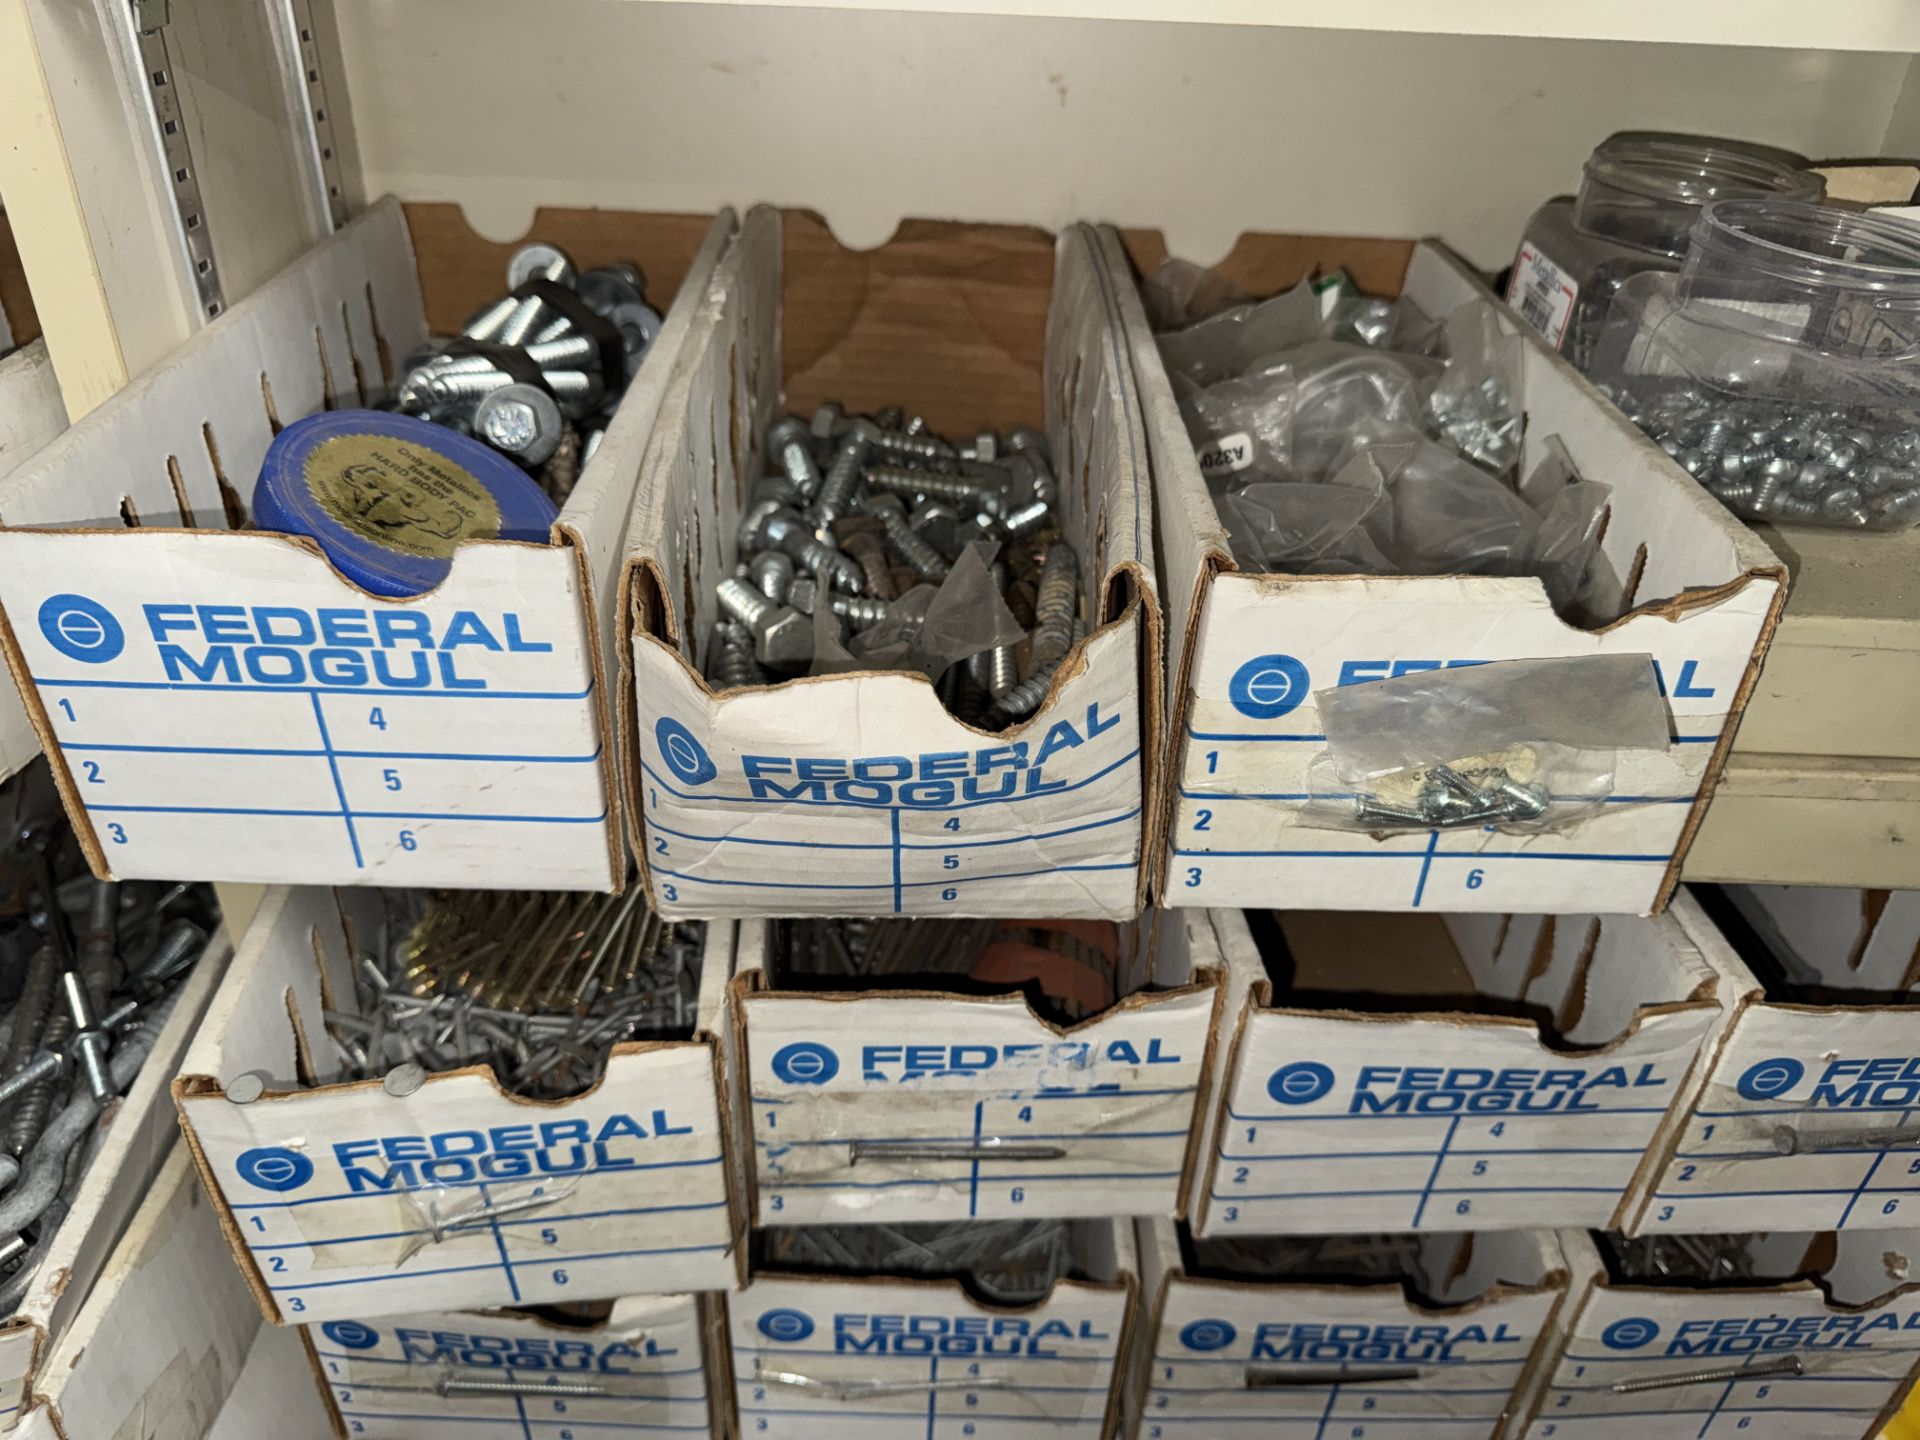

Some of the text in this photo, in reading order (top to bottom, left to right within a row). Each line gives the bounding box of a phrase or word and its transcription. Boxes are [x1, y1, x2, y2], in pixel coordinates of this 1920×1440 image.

[398, 447, 481, 501] Only Metallics
[408, 465, 454, 495] has the
[371, 451, 477, 518] HARD BODY PAC
[142, 604, 553, 653] FEDERAL
[157, 645, 487, 689] MOGUL
[59, 699, 76, 722] 1
[369, 707, 387, 730] 4
[740, 702, 1121, 780] FEDERAL
[1205, 751, 1219, 773] 1
[83, 761, 105, 784] 2
[383, 769, 402, 791] 5
[746, 767, 1069, 806] MOGUL
[649, 788, 657, 808] 1
[943, 818, 961, 832] 4
[1193, 810, 1212, 831] 2
[107, 823, 128, 844] 3
[400, 829, 417, 851] 6
[654, 837, 670, 856] 2
[943, 855, 960, 869] 5
[1185, 868, 1202, 888] 3
[1466, 868, 1485, 890] 6
[663, 884, 678, 901] 3
[941, 888, 957, 901] 6
[1355, 1063, 1667, 1090] FEDERAL
[1348, 1088, 1599, 1113] MOGUL
[1810, 1081, 1920, 1107] MO
[766, 1111, 776, 1128] 1
[1018, 1106, 1031, 1121] 4
[1245, 1128, 1256, 1143] 1
[1490, 1122, 1504, 1137] 4
[1702, 1124, 1715, 1140] 1
[331, 1109, 694, 1168] FEDERAL
[346, 1143, 635, 1192] MOGUL
[1233, 1167, 1249, 1182] 2
[1472, 1161, 1487, 1175] 5
[1678, 1165, 1696, 1181] 2
[771, 1195, 784, 1210] 3
[1011, 1187, 1024, 1203] 6
[1223, 1206, 1239, 1221] 3
[1456, 1200, 1471, 1215] 6
[1658, 1206, 1674, 1221] 3
[1882, 1199, 1899, 1214] 6
[250, 1216, 267, 1233] 1
[542, 1228, 558, 1245] 5
[269, 1256, 289, 1272] 2
[552, 1269, 569, 1285] 6
[288, 1297, 306, 1313] 3
[833, 1313, 1109, 1340] FEDERAL
[1674, 1312, 1920, 1337] FEDERAL
[1253, 1323, 1522, 1344] FEDERAL
[394, 1328, 678, 1357] FEDERAL
[835, 1334, 1058, 1357] MOGUL
[1664, 1331, 1872, 1356] MOGUL
[402, 1342, 631, 1374] MOGUL
[1251, 1341, 1467, 1363] MOGUL
[329, 1362, 340, 1374] 1
[967, 1363, 979, 1376] 4
[1165, 1367, 1173, 1379] 1
[1574, 1366, 1585, 1377] 1
[340, 1392, 353, 1403] 2
[753, 1387, 765, 1400] 2
[965, 1393, 978, 1405] 5
[1755, 1386, 1769, 1399] 5
[554, 1400, 567, 1413] 5
[1156, 1397, 1168, 1409] 2
[1363, 1398, 1375, 1410] 5
[1556, 1395, 1571, 1408] 2
[352, 1420, 364, 1433] 3
[757, 1418, 768, 1431] 3
[963, 1422, 975, 1436] 6
[1736, 1416, 1750, 1429] 6
[560, 1429, 573, 1440] 6
[1150, 1426, 1161, 1438] 3
[1352, 1426, 1364, 1438] 6
[1542, 1425, 1557, 1437] 3
